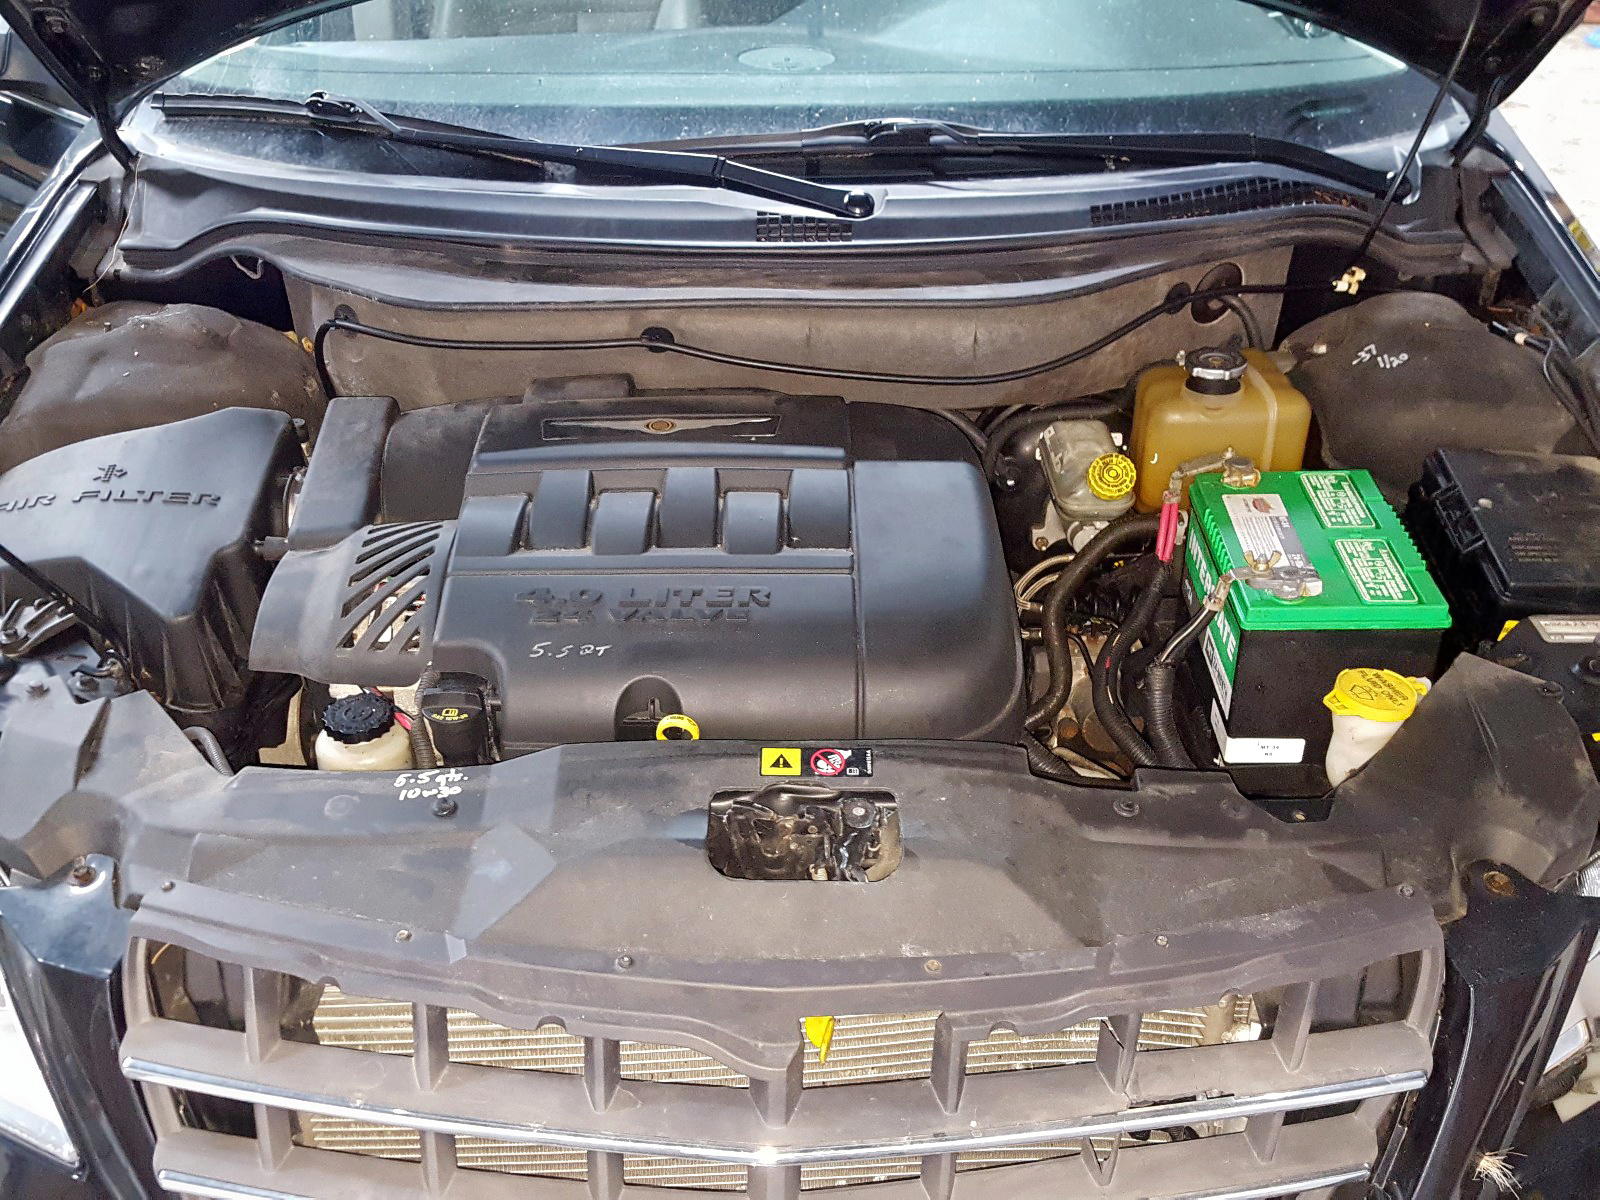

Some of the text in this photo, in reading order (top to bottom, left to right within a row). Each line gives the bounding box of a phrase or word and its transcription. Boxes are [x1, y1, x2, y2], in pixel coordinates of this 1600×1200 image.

[0, 490, 221, 512] AIR FILTER
[617, 586, 772, 608] LITER
